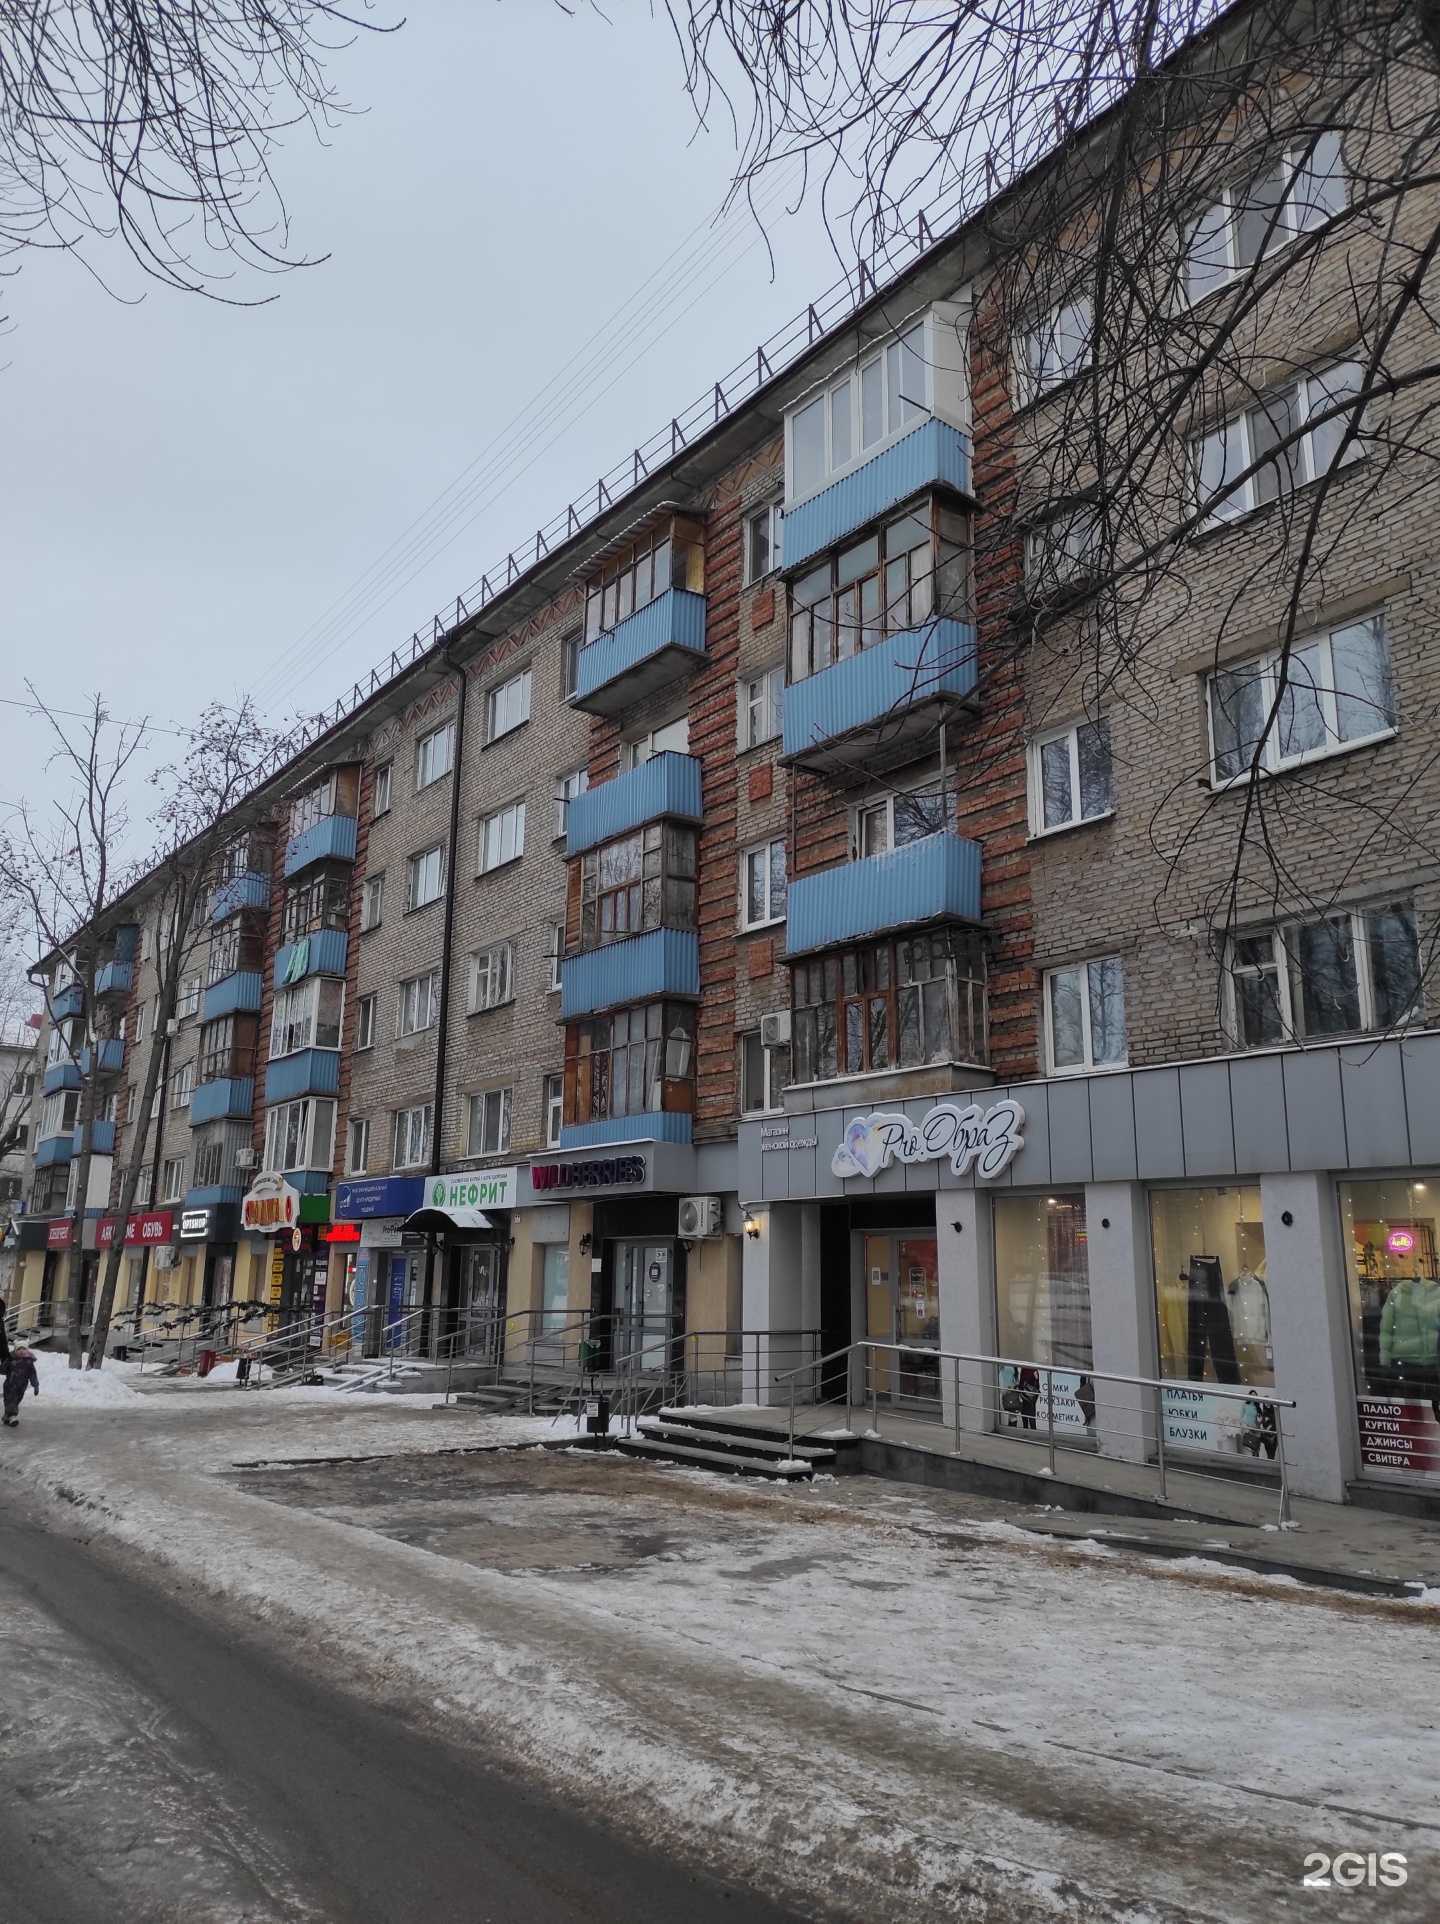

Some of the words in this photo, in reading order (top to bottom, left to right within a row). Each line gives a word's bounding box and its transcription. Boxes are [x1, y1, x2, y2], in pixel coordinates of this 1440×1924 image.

[760, 1127, 790, 1137] Магазин
[760, 1139, 788, 1152] женской
[788, 1138, 818, 1151] одежды
[531, 1155, 647, 1191] WILDBERRIES
[449, 1181, 508, 1207] НЕФРИТ
[142, 1220, 163, 1238] ОБУВЬ
[1042, 1383, 1070, 1393] СМКИ
[1363, 1404, 1401, 1416] ПАЛЬТО
[1364, 1420, 1400, 1432] КУРТКИ
[1169, 1426, 1208, 1441] БЛУЗКИ
[1366, 1436, 1413, 1449] ДЖИНСЫ
[1368, 1453, 1410, 1466] СВИТЕРА
